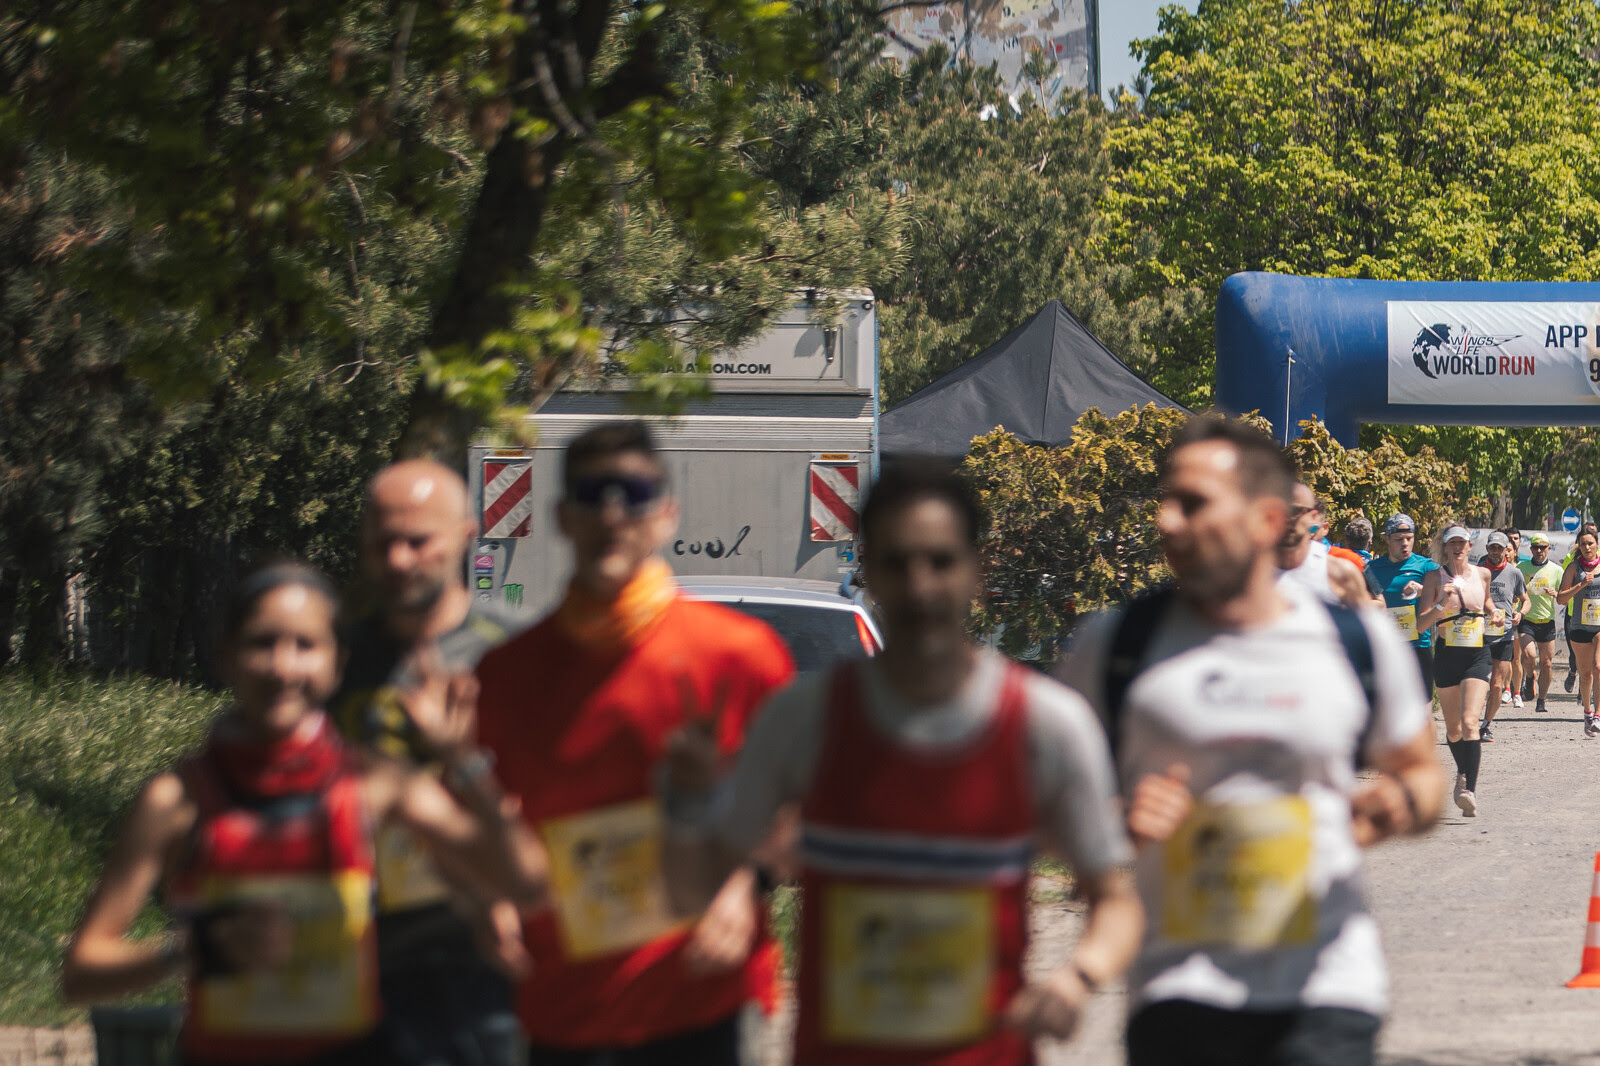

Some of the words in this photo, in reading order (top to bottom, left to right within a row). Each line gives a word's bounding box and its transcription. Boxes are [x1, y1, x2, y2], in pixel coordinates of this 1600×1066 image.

[1450, 335, 1495, 346] WINGS
[1545, 324, 1588, 348] APP
[1456, 345, 1482, 355] LIFE
